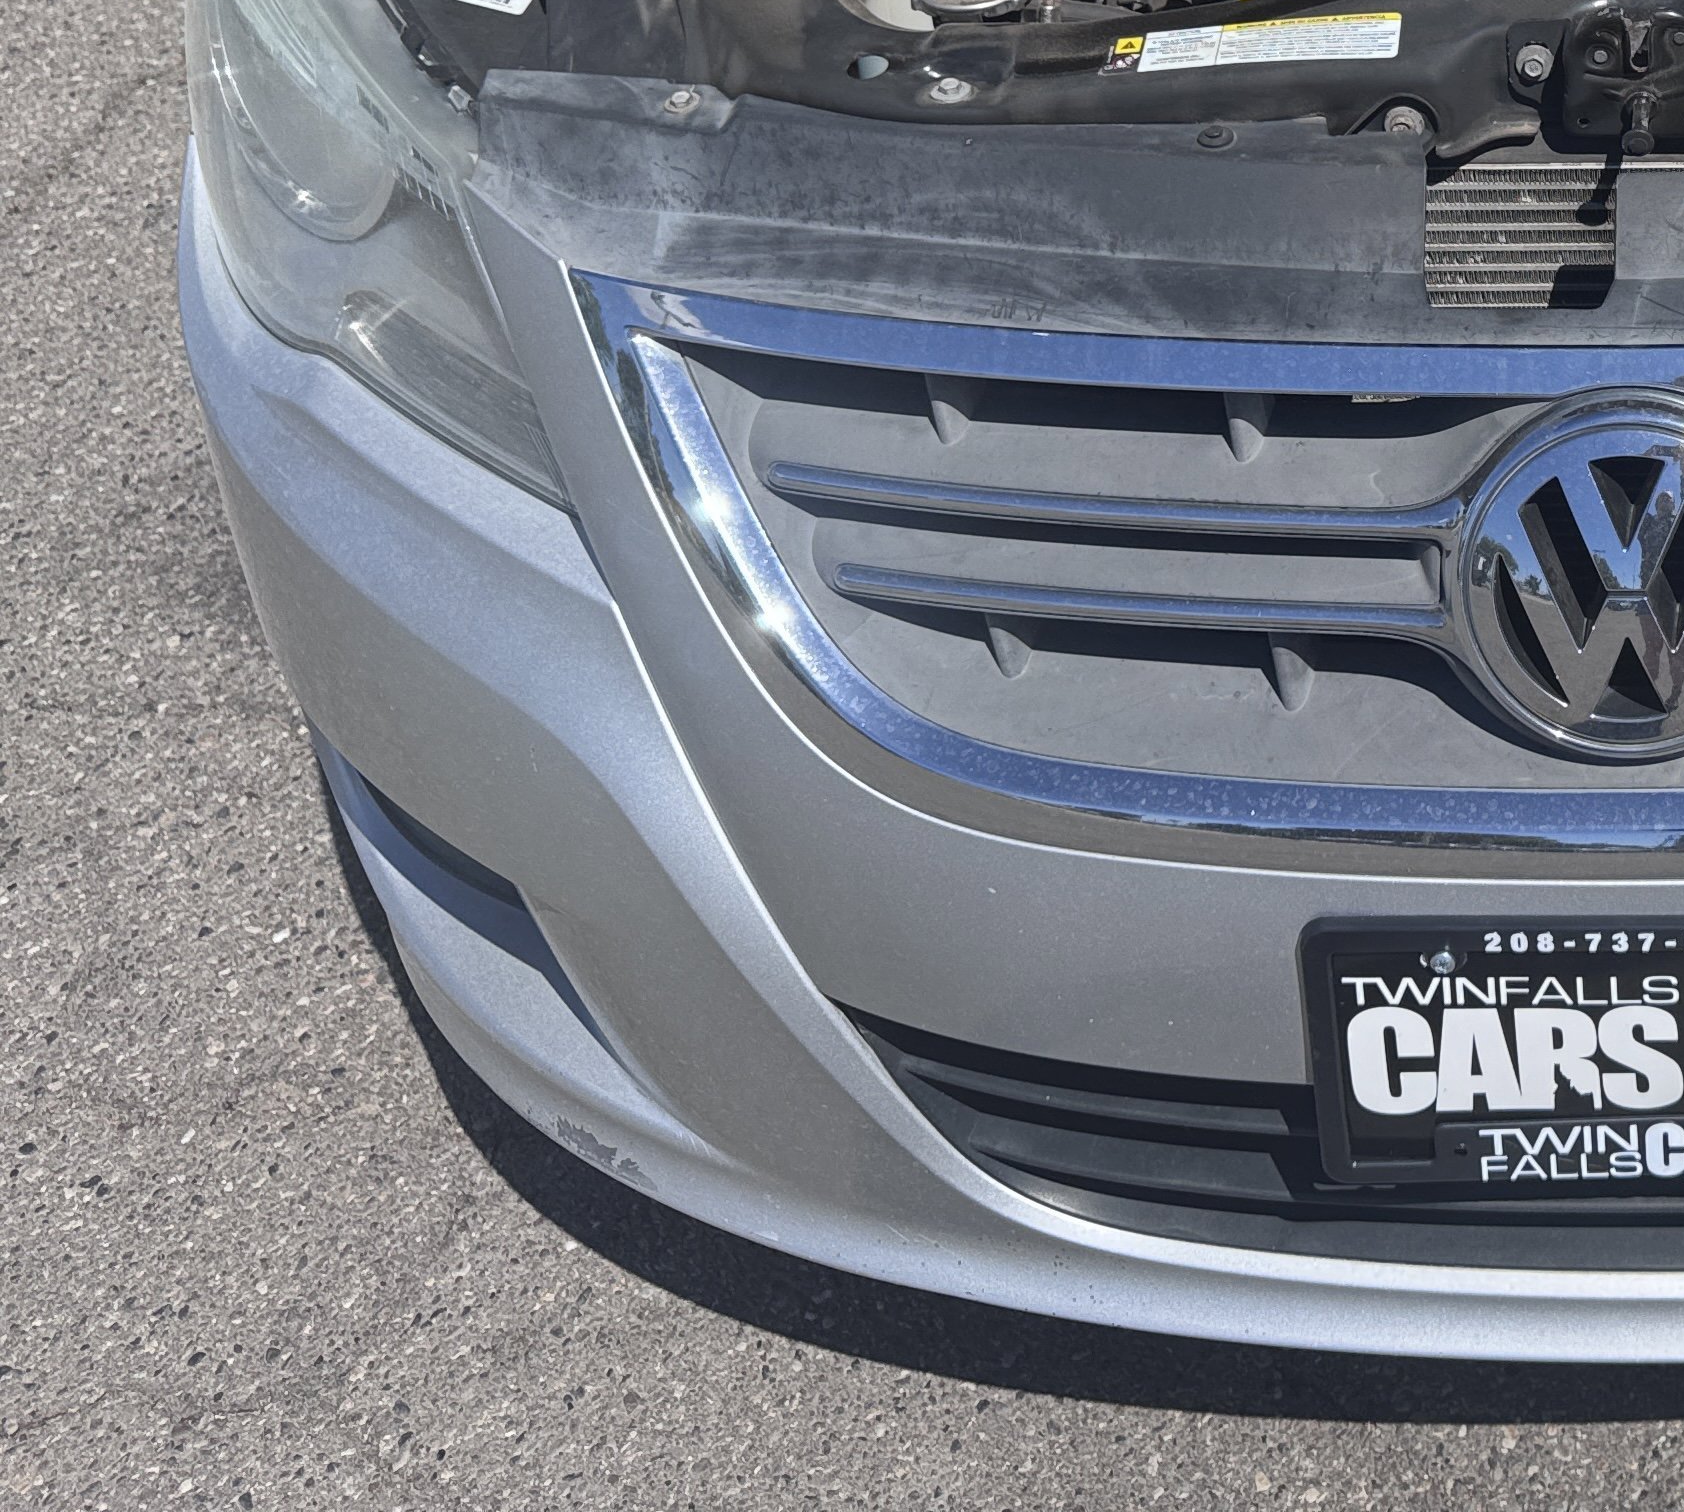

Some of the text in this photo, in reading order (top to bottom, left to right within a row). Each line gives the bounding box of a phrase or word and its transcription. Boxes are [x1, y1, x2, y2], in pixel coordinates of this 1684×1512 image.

[1347, 1005, 1684, 1116] CARS
[1478, 1124, 1640, 1156] TWIN
[1480, 1151, 1644, 1183] FALLS
